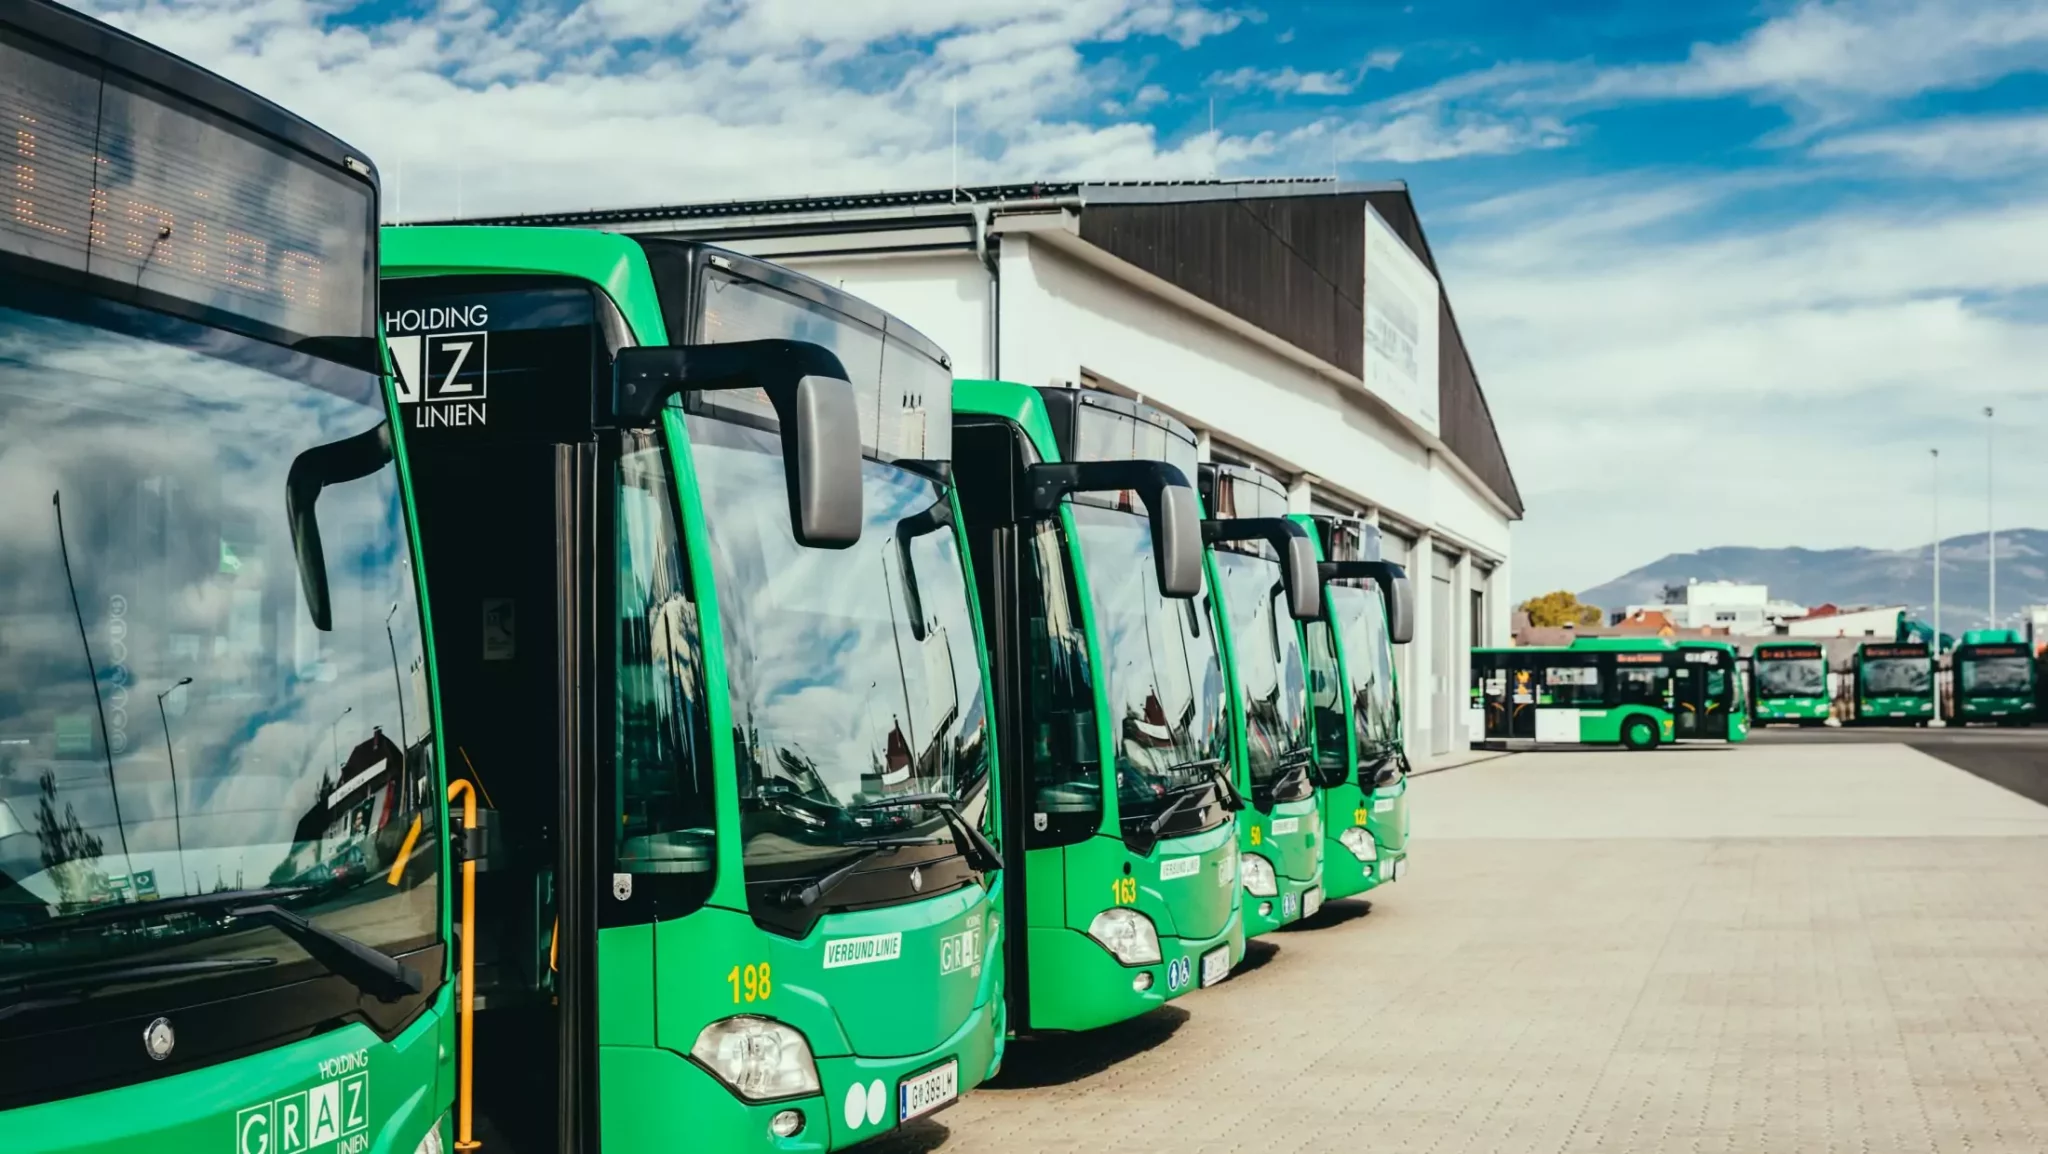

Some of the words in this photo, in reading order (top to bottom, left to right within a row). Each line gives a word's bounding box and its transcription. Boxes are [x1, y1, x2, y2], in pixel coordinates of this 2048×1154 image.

[385, 305, 489, 332] HOLDING
[416, 402, 487, 428] LINIEN
[1251, 826, 1261, 846] 50
[1112, 877, 1136, 905] 163
[828, 941, 874, 963] VERBUND
[875, 937, 898, 957] LINIE
[941, 931, 980, 971] GRAZ
[728, 962, 771, 1004] 198
[319, 1048, 369, 1080] HOLDING
[241, 1080, 364, 1154] GRAZ
